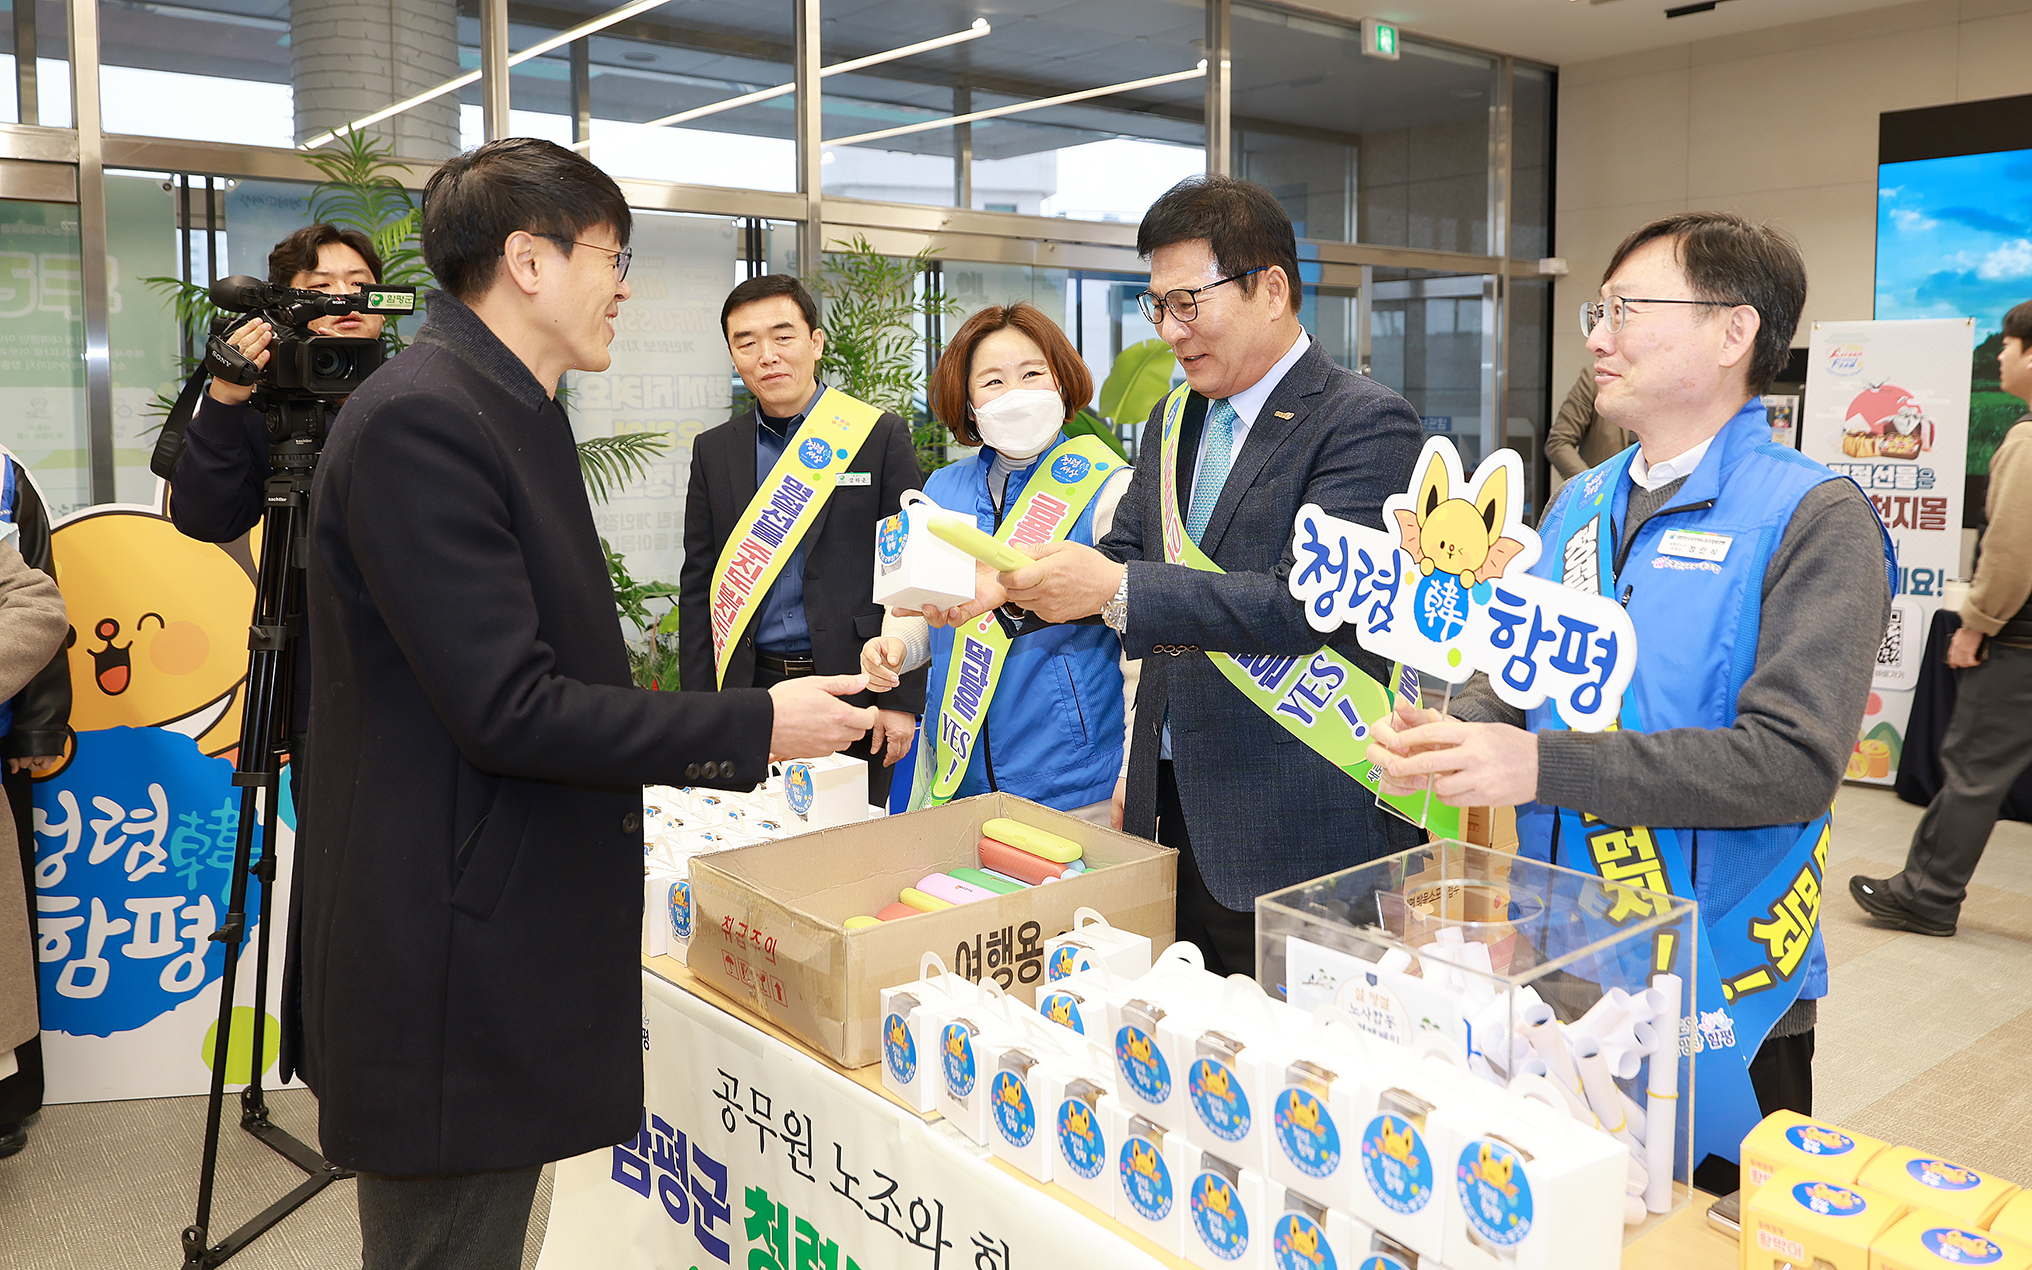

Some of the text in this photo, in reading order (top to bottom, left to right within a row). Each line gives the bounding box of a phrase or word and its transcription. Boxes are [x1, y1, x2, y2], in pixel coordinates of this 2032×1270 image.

[211, 349, 232, 369] SONY
[749, 473, 815, 550] 명절선물
[722, 537, 773, 596] 주지도
[1298, 516, 1619, 714] 청렴 韓 함평
[953, 637, 993, 722] 덕담은
[36, 894, 217, 999] 함평
[954, 920, 1044, 991] 여행용
[713, 1067, 952, 1270] 공무원 노조와
